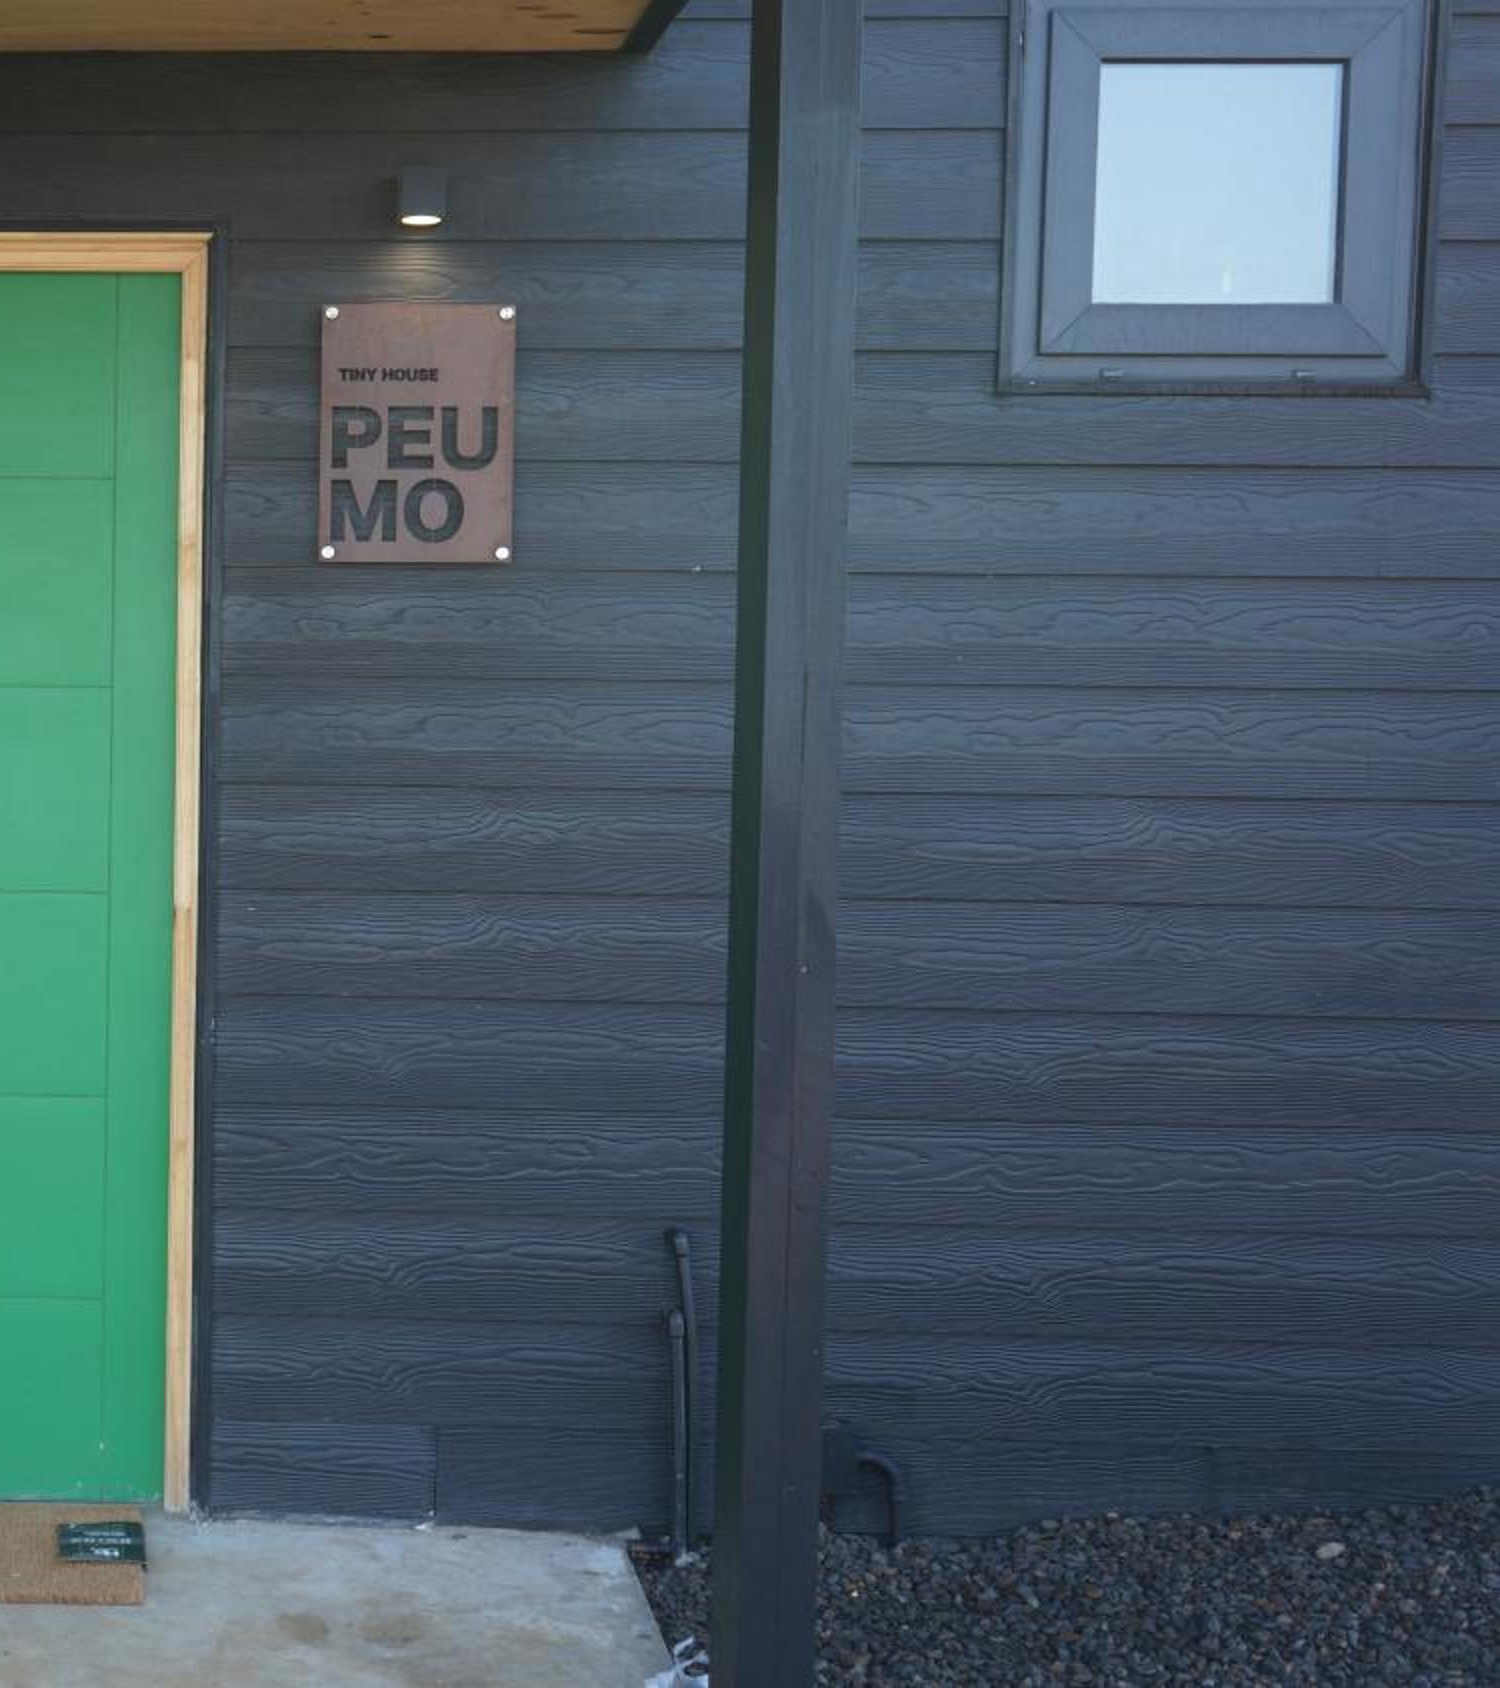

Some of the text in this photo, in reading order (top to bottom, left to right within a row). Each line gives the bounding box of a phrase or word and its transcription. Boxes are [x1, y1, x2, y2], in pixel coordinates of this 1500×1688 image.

[338, 368, 439, 382] TINY HOUSE
[330, 405, 498, 471] PEU
[330, 478, 465, 543] MO
